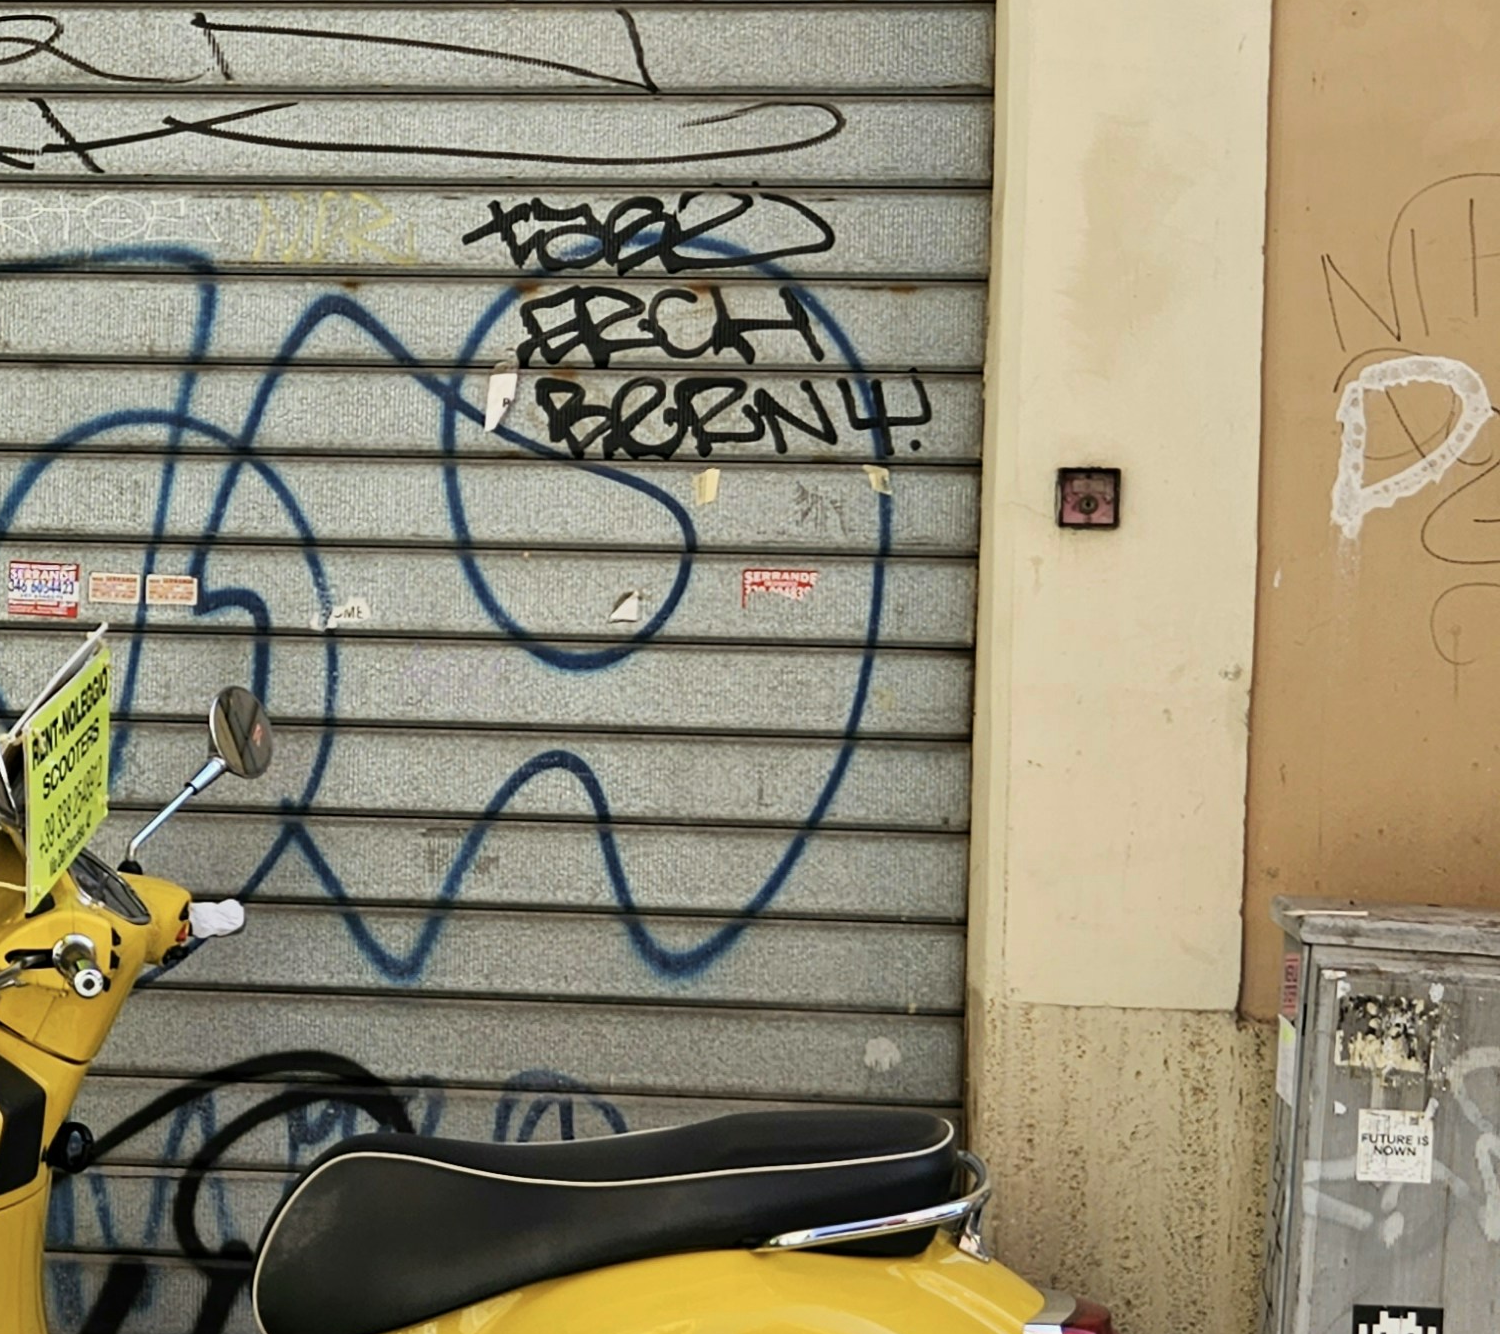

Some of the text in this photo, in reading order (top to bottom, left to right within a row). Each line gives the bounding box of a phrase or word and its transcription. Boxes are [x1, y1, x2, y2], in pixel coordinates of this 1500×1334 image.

[743, 571, 818, 586] SERRANDE
[43, 716, 100, 800] SCOOTERS
[1361, 1133, 1430, 1146] FUTURE IS
